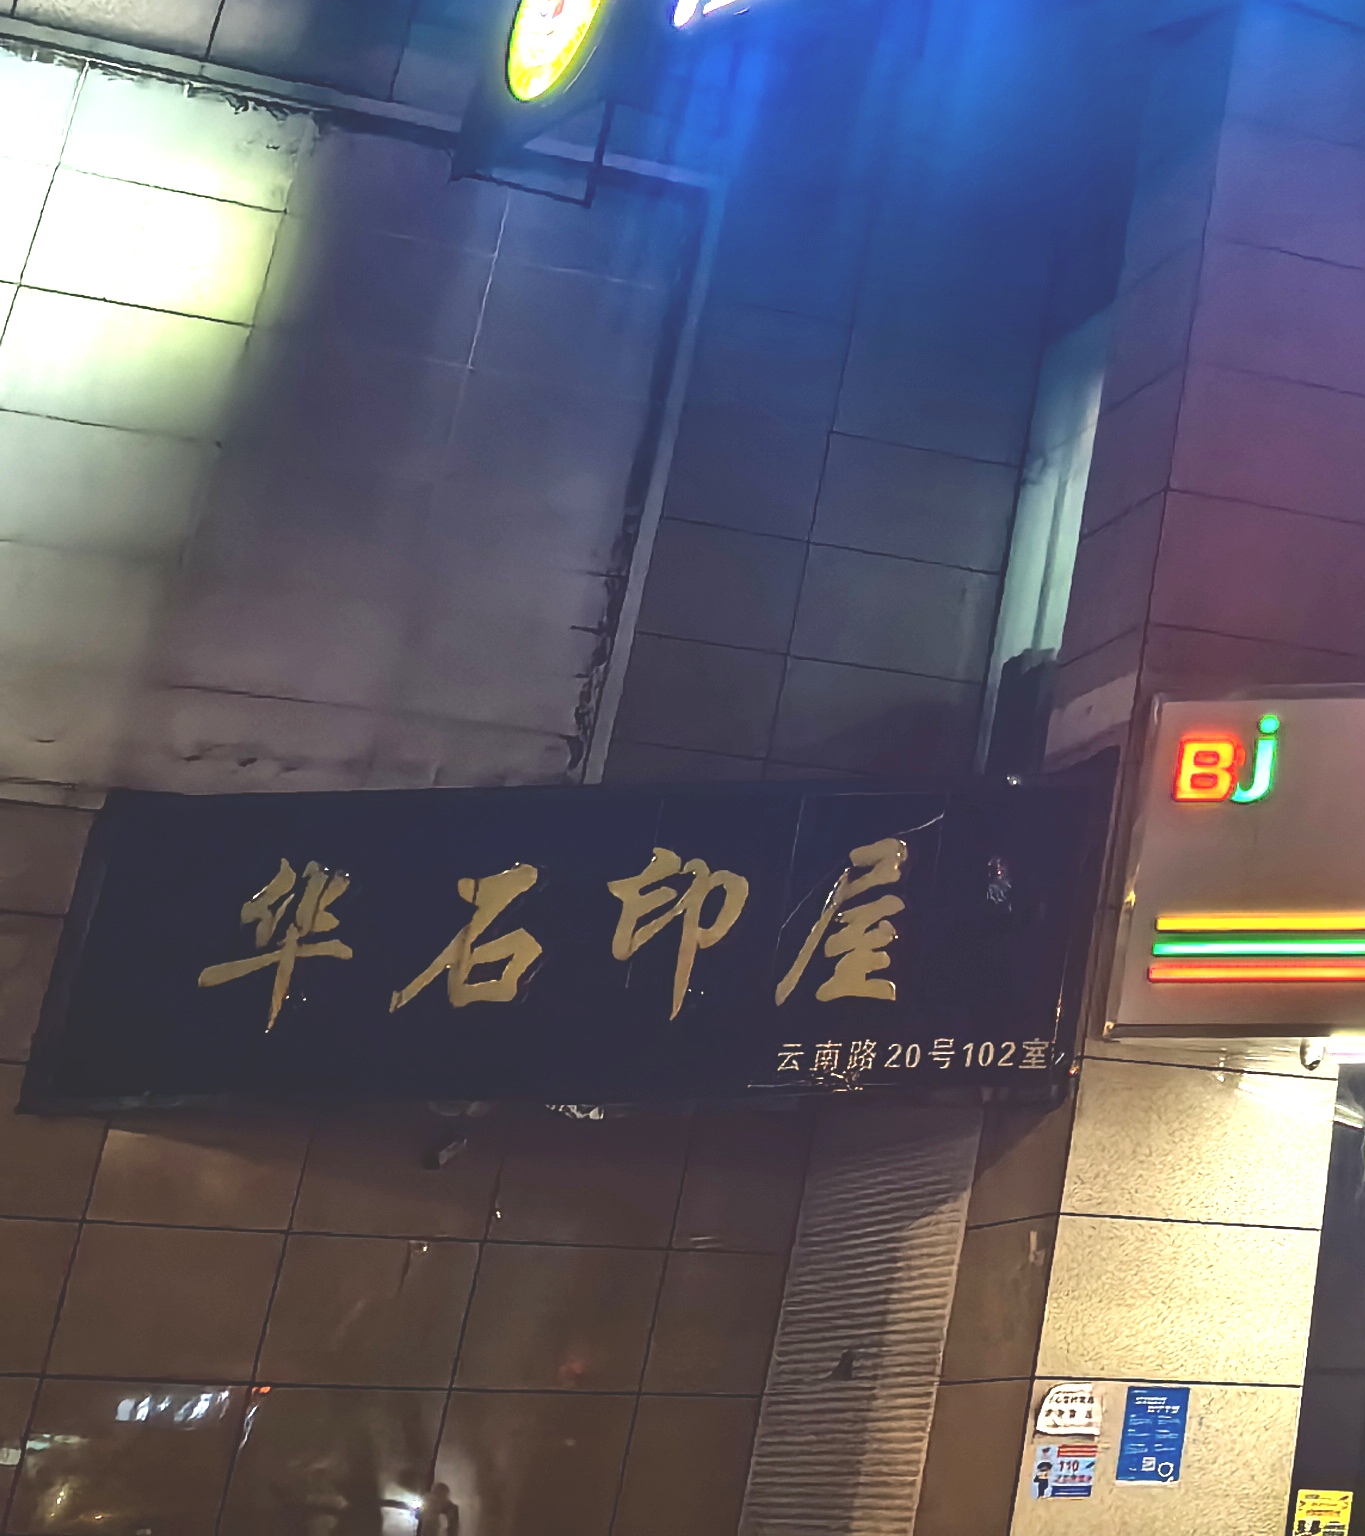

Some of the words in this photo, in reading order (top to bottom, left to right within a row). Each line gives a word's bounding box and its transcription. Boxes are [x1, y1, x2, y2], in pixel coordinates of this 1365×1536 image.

[200, 838, 908, 1032] 华石印屋
[777, 1038, 1050, 1071] 云南路20号102室
